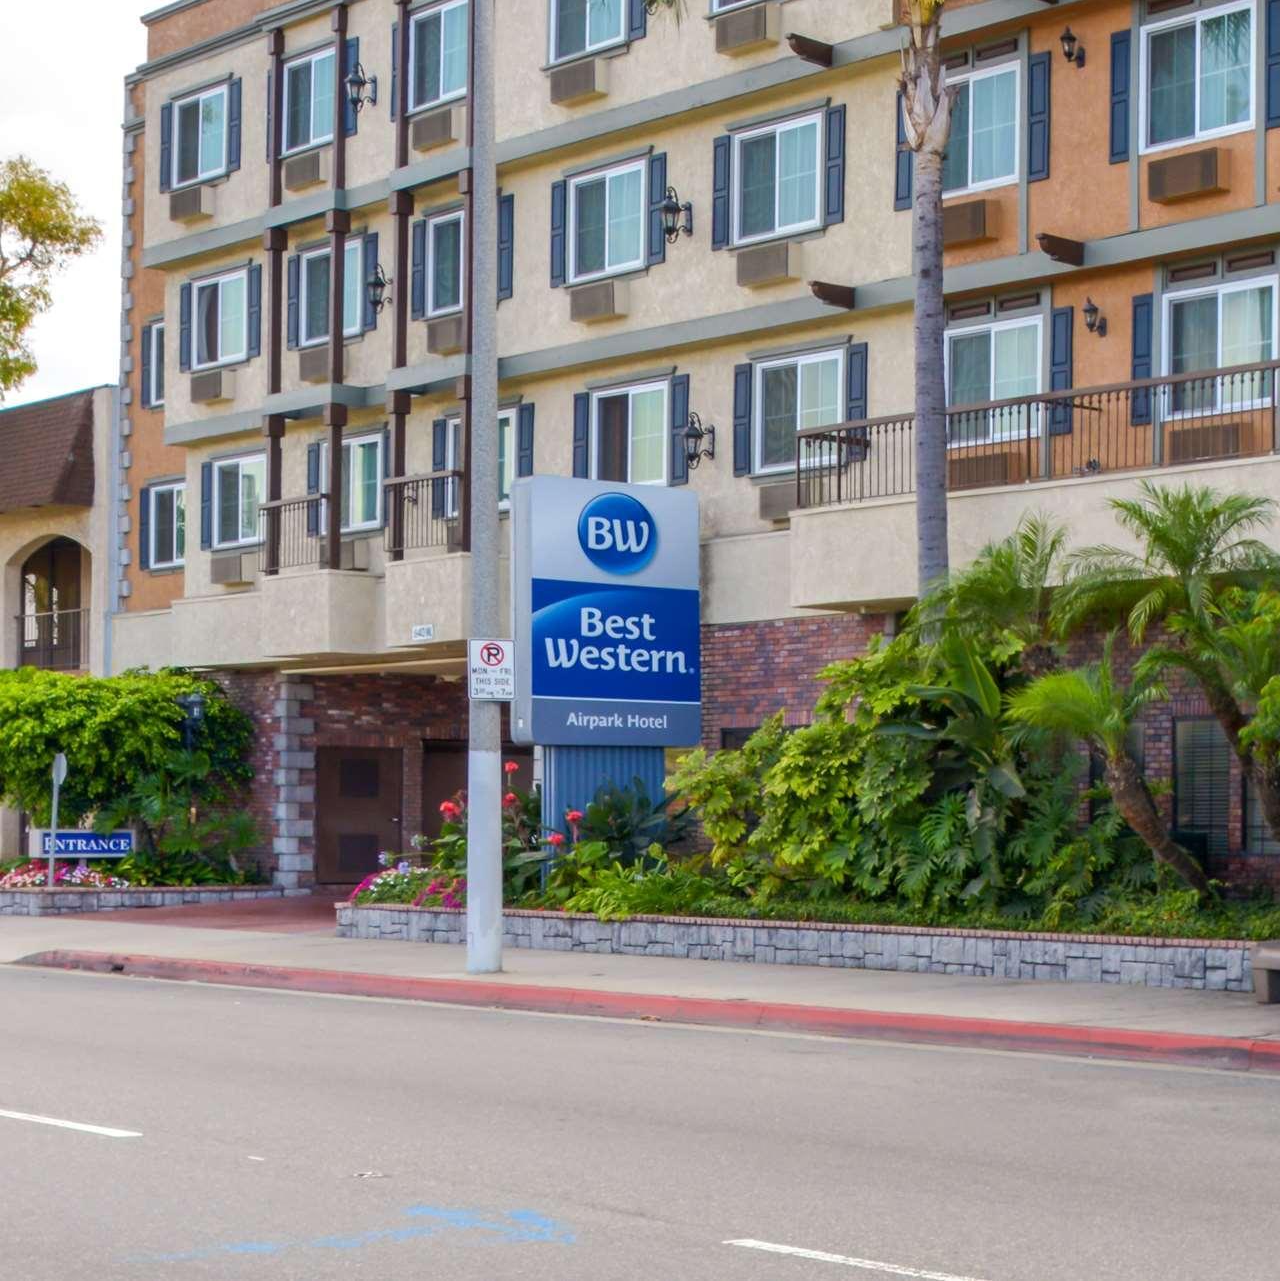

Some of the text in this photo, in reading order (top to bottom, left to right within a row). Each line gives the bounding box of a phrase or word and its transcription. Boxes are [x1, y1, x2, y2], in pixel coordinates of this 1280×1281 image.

[587, 516, 650, 553] BW
[580, 607, 657, 641] Best
[545, 637, 688, 675] Western
[566, 712, 668, 730] Airpark Hotel
